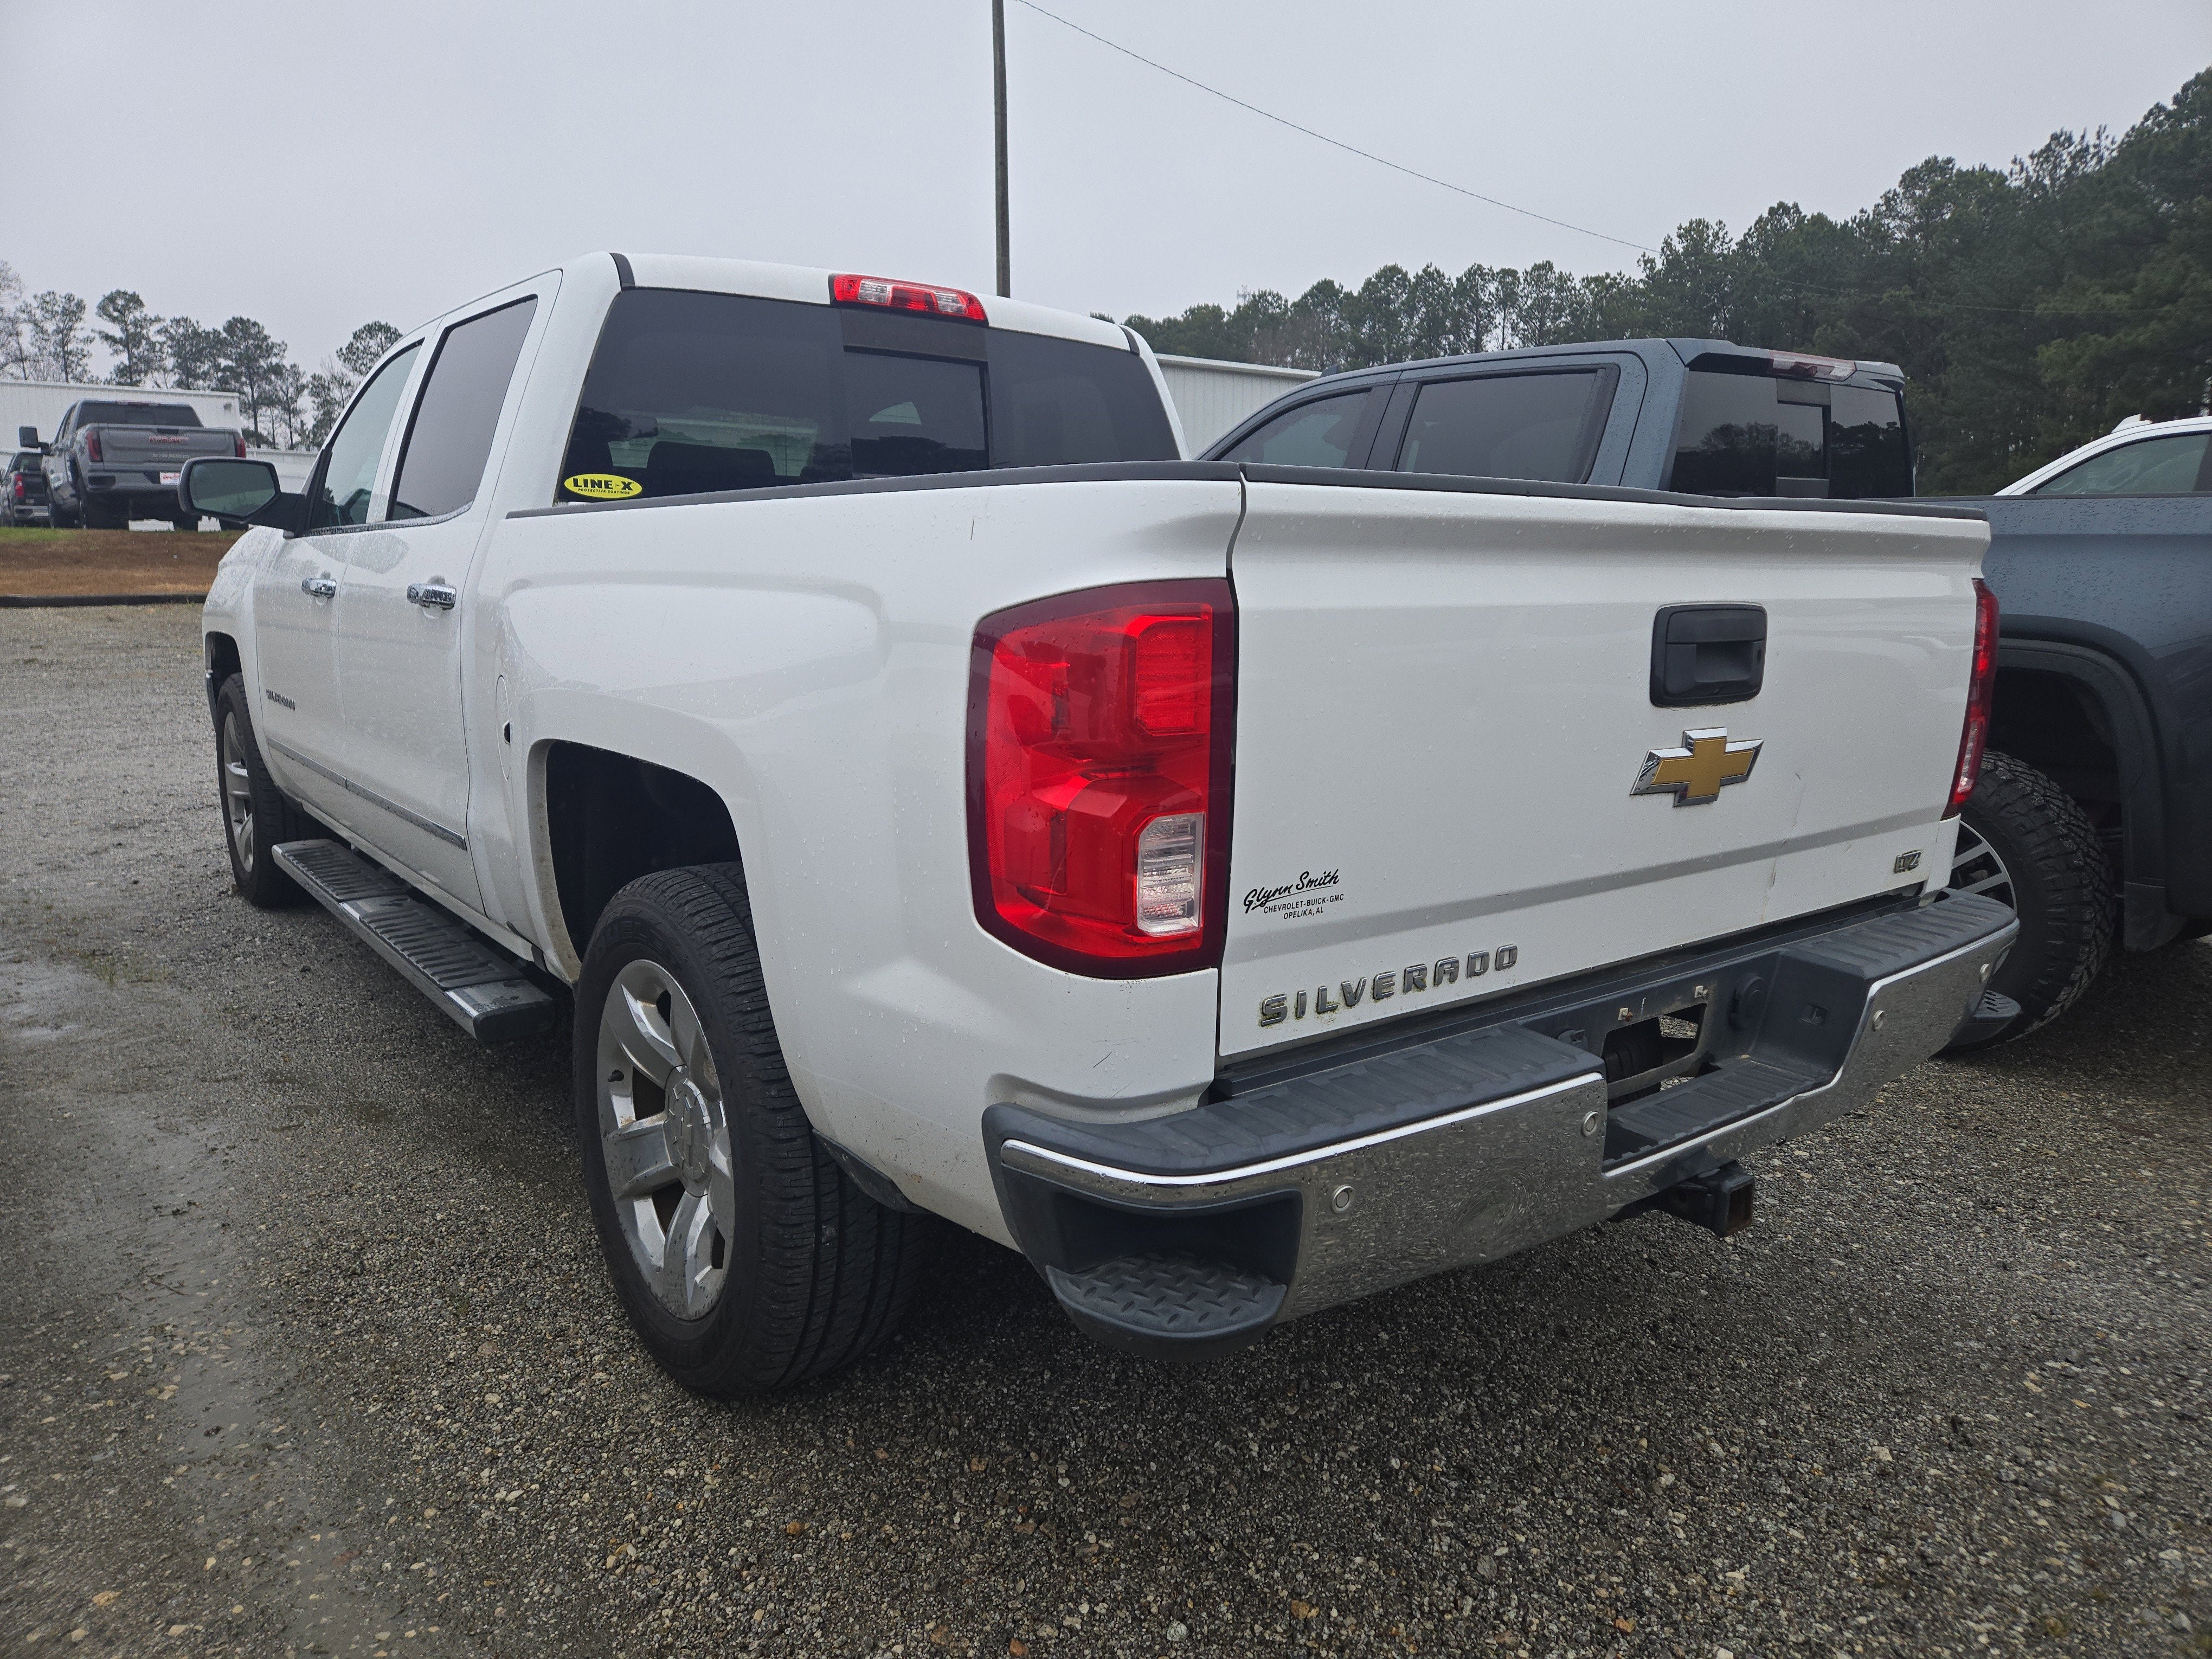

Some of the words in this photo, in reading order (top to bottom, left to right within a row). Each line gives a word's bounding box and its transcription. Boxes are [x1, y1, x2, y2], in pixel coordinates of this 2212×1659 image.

[1894, 850, 1921, 874] LTZ
[1243, 884, 1294, 914] Glynn
[1295, 869, 1340, 890] Smith
[1264, 893, 1344, 914] CHEVROLET-BUICK-GMC
[1283, 908, 1315, 919] OPELIKA,
[1260, 944, 1519, 1026] SILVERADO
